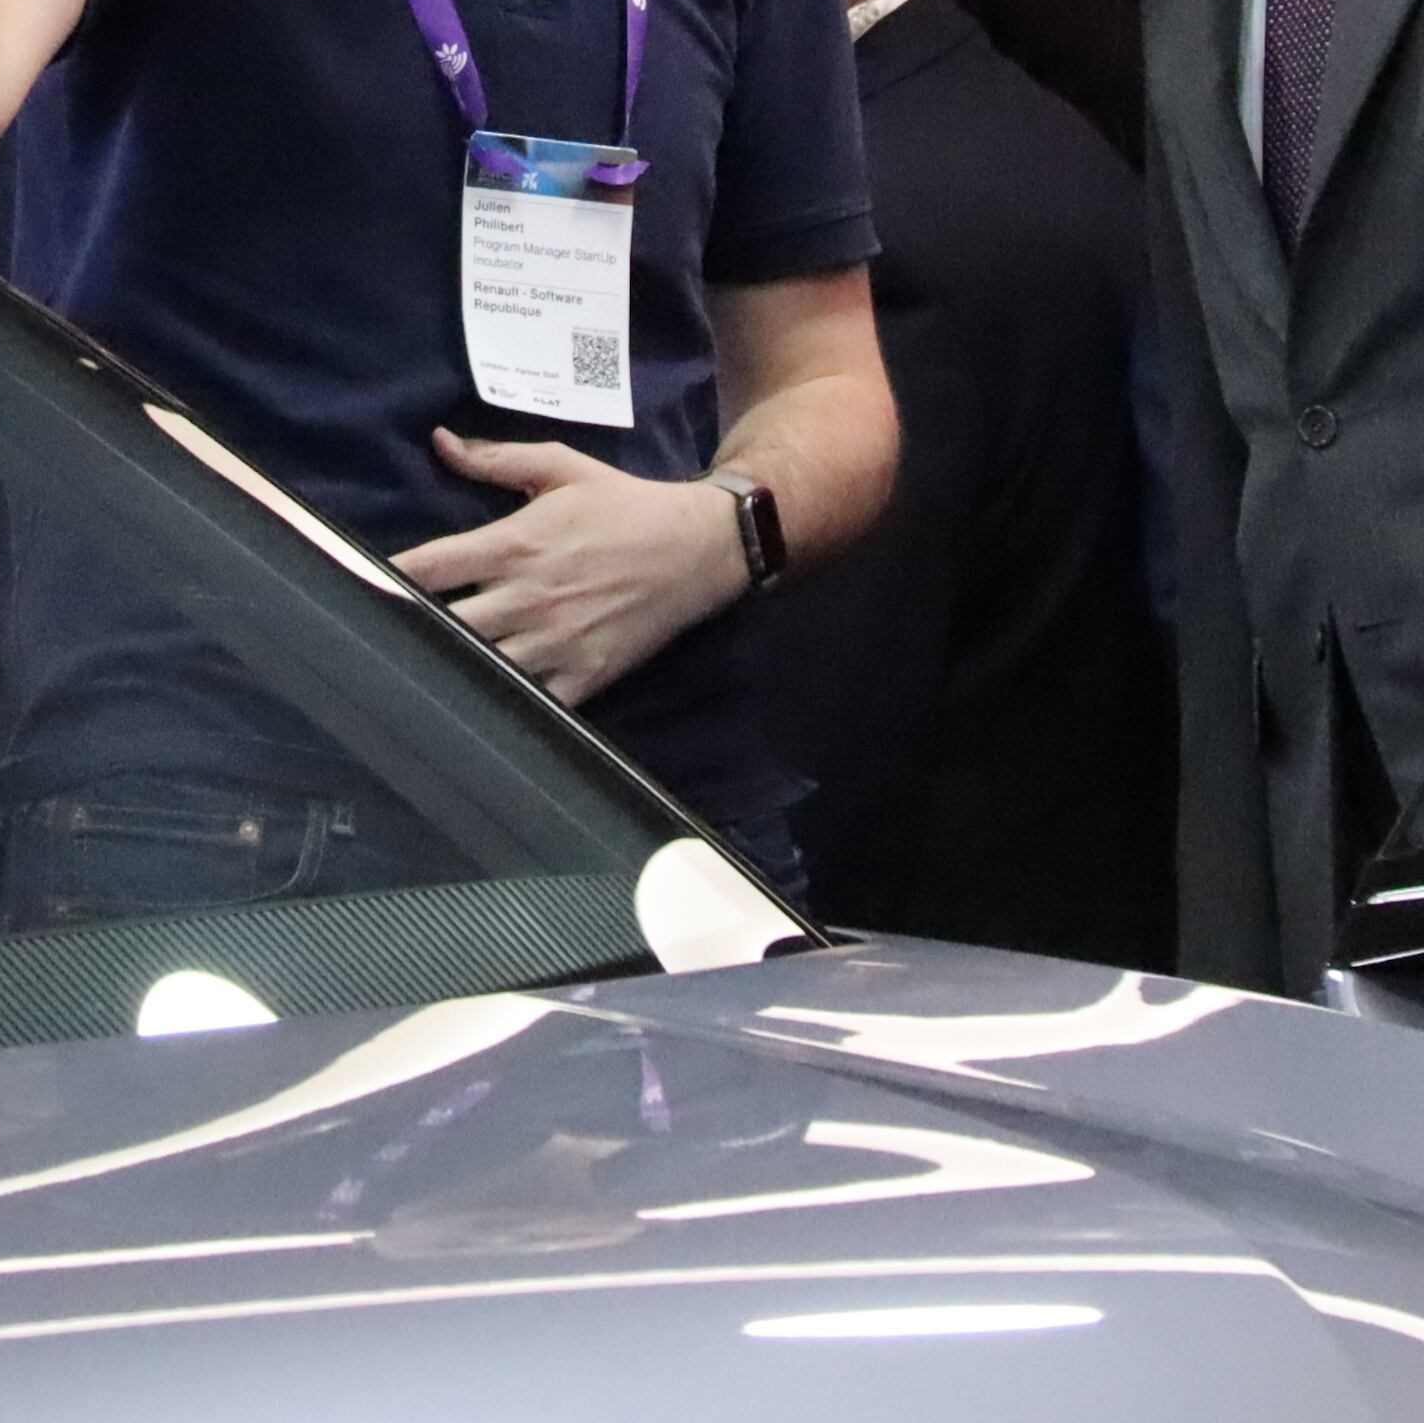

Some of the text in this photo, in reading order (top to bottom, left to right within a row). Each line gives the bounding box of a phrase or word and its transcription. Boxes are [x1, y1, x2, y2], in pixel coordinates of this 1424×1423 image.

[474, 199, 512, 214] Julien
[474, 216, 525, 234] Philibert
[473, 236, 521, 253] Program
[523, 242, 571, 261] Manager
[473, 255, 525, 271] Incubator
[473, 280, 520, 298] Renault
[530, 288, 584, 305] Software
